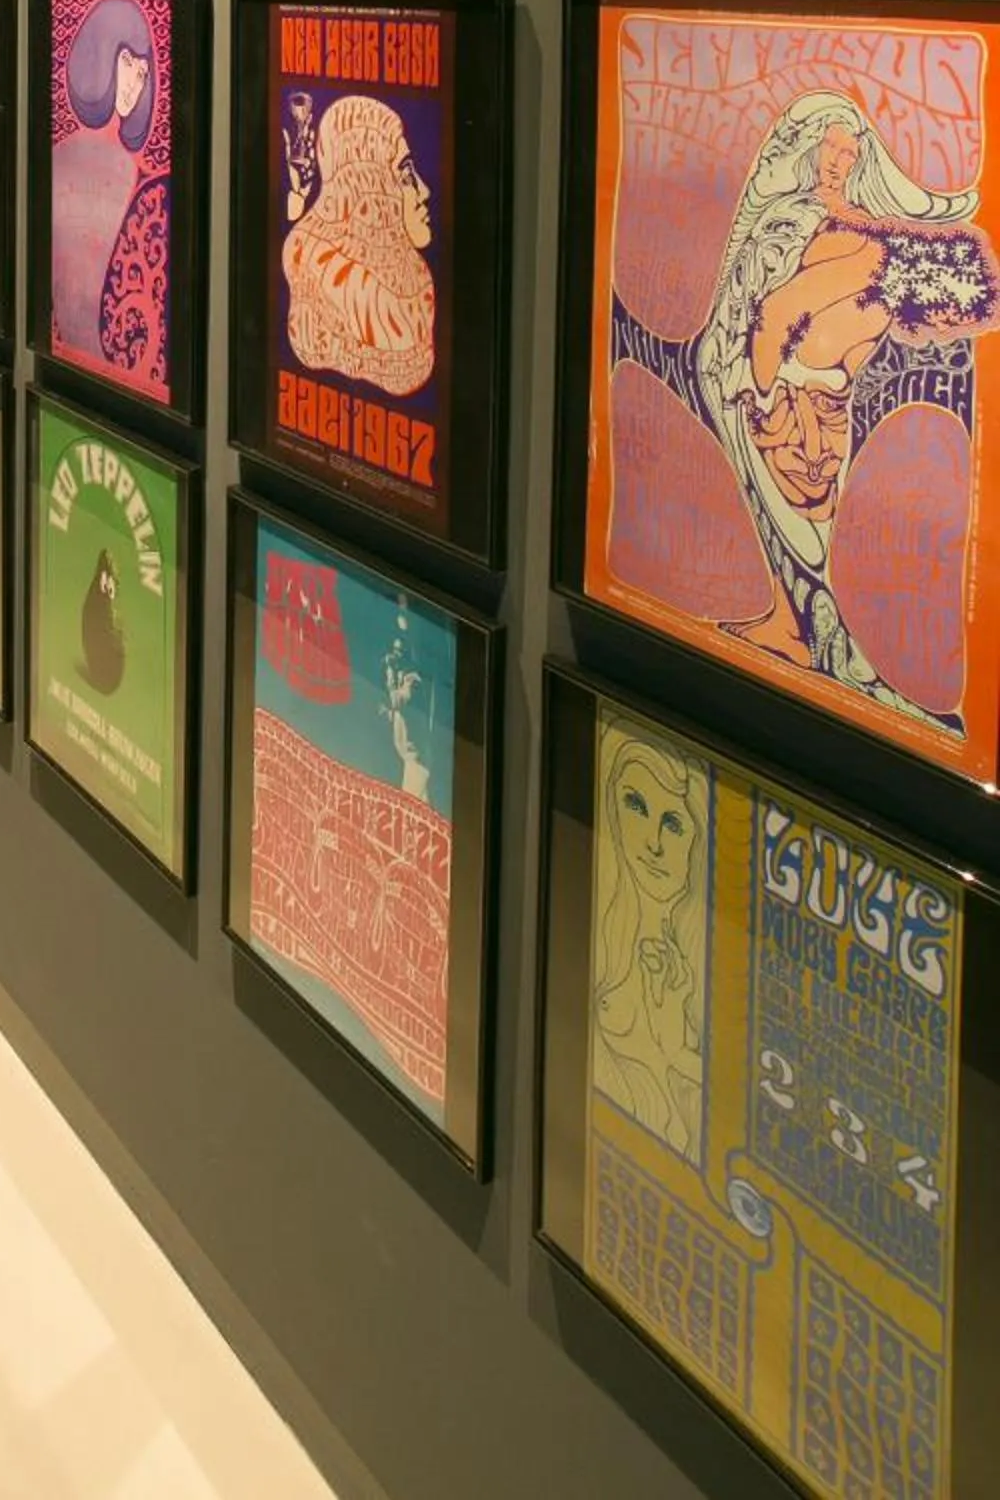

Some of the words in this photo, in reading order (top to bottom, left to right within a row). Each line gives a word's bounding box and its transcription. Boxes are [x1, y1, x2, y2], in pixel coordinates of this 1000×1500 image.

[281, 16, 321, 77] NEW
[325, 18, 380, 82] YEAR
[384, 21, 440, 88] BASH
[49, 457, 78, 533] LED
[74, 442, 164, 597] ZEPPELIN
[762, 802, 951, 998] LOVE
[760, 1049, 796, 1110] 2
[828, 1097, 870, 1164] 3
[898, 1154, 941, 1212] 4
